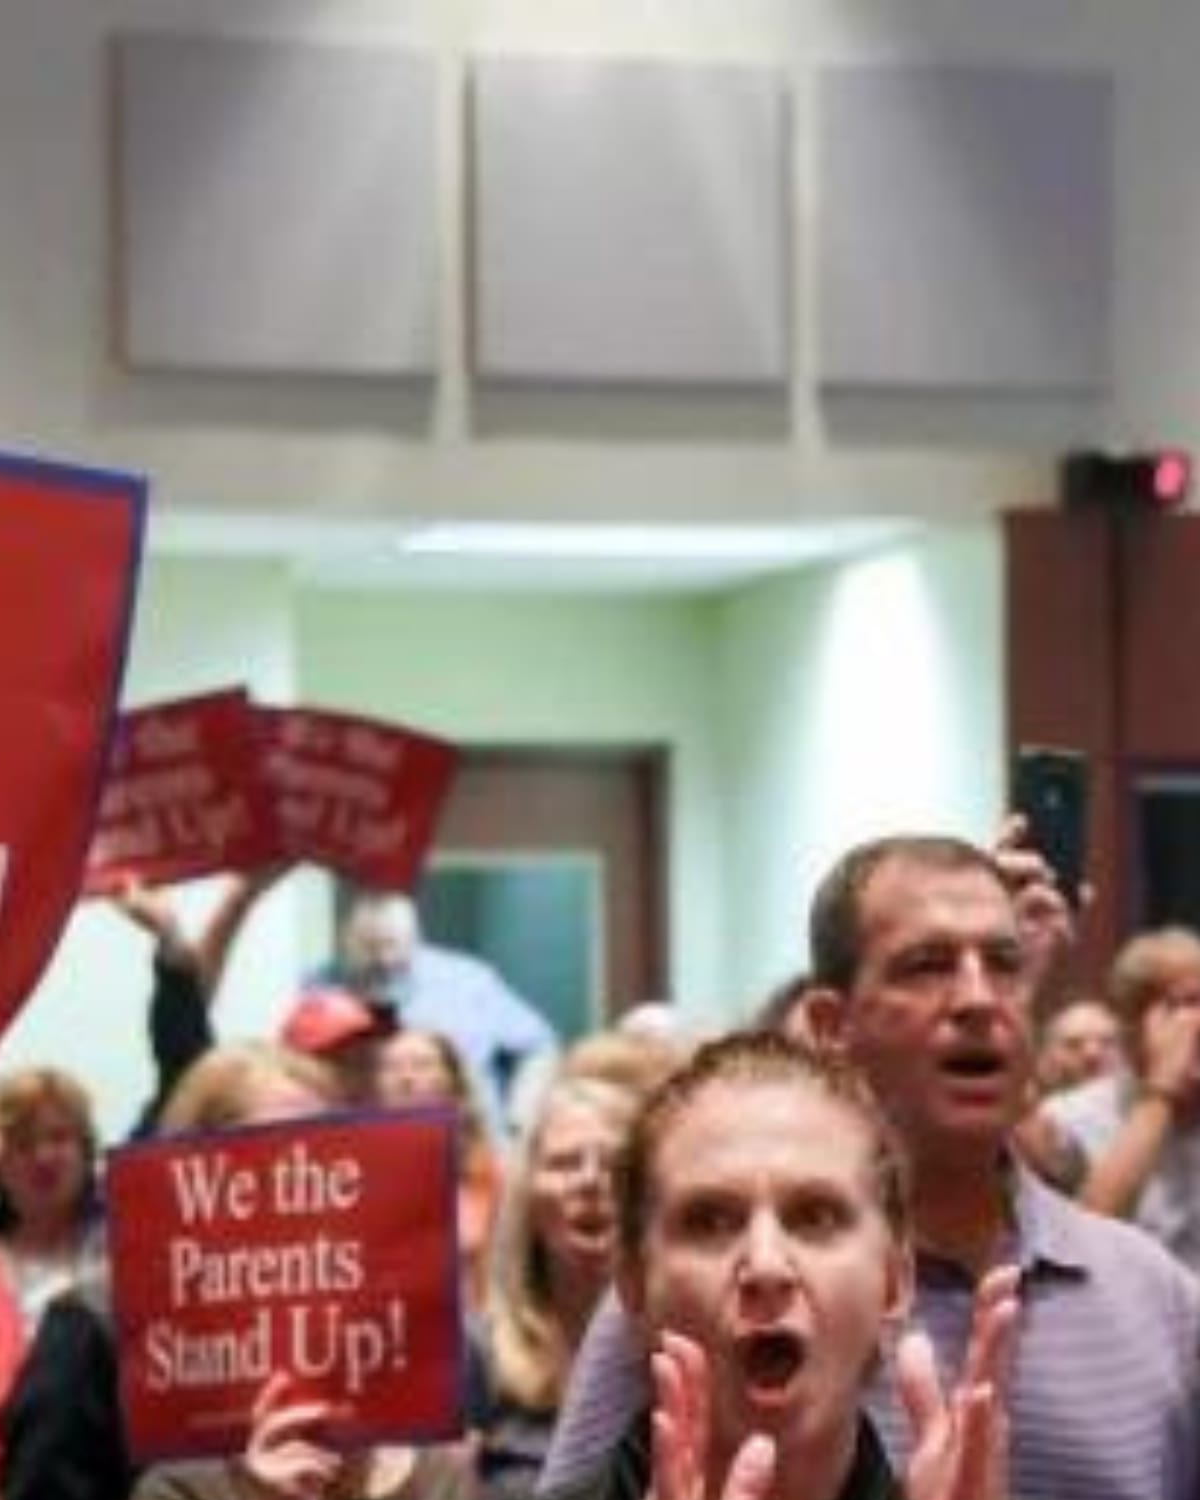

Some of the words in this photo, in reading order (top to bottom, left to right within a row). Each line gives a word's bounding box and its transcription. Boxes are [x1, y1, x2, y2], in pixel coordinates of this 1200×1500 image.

[169, 1152, 258, 1223] We
[271, 1142, 362, 1216] the
[169, 1234, 366, 1306] Parents
[145, 1308, 273, 1392] Stand
[289, 1299, 406, 1393] Up!
